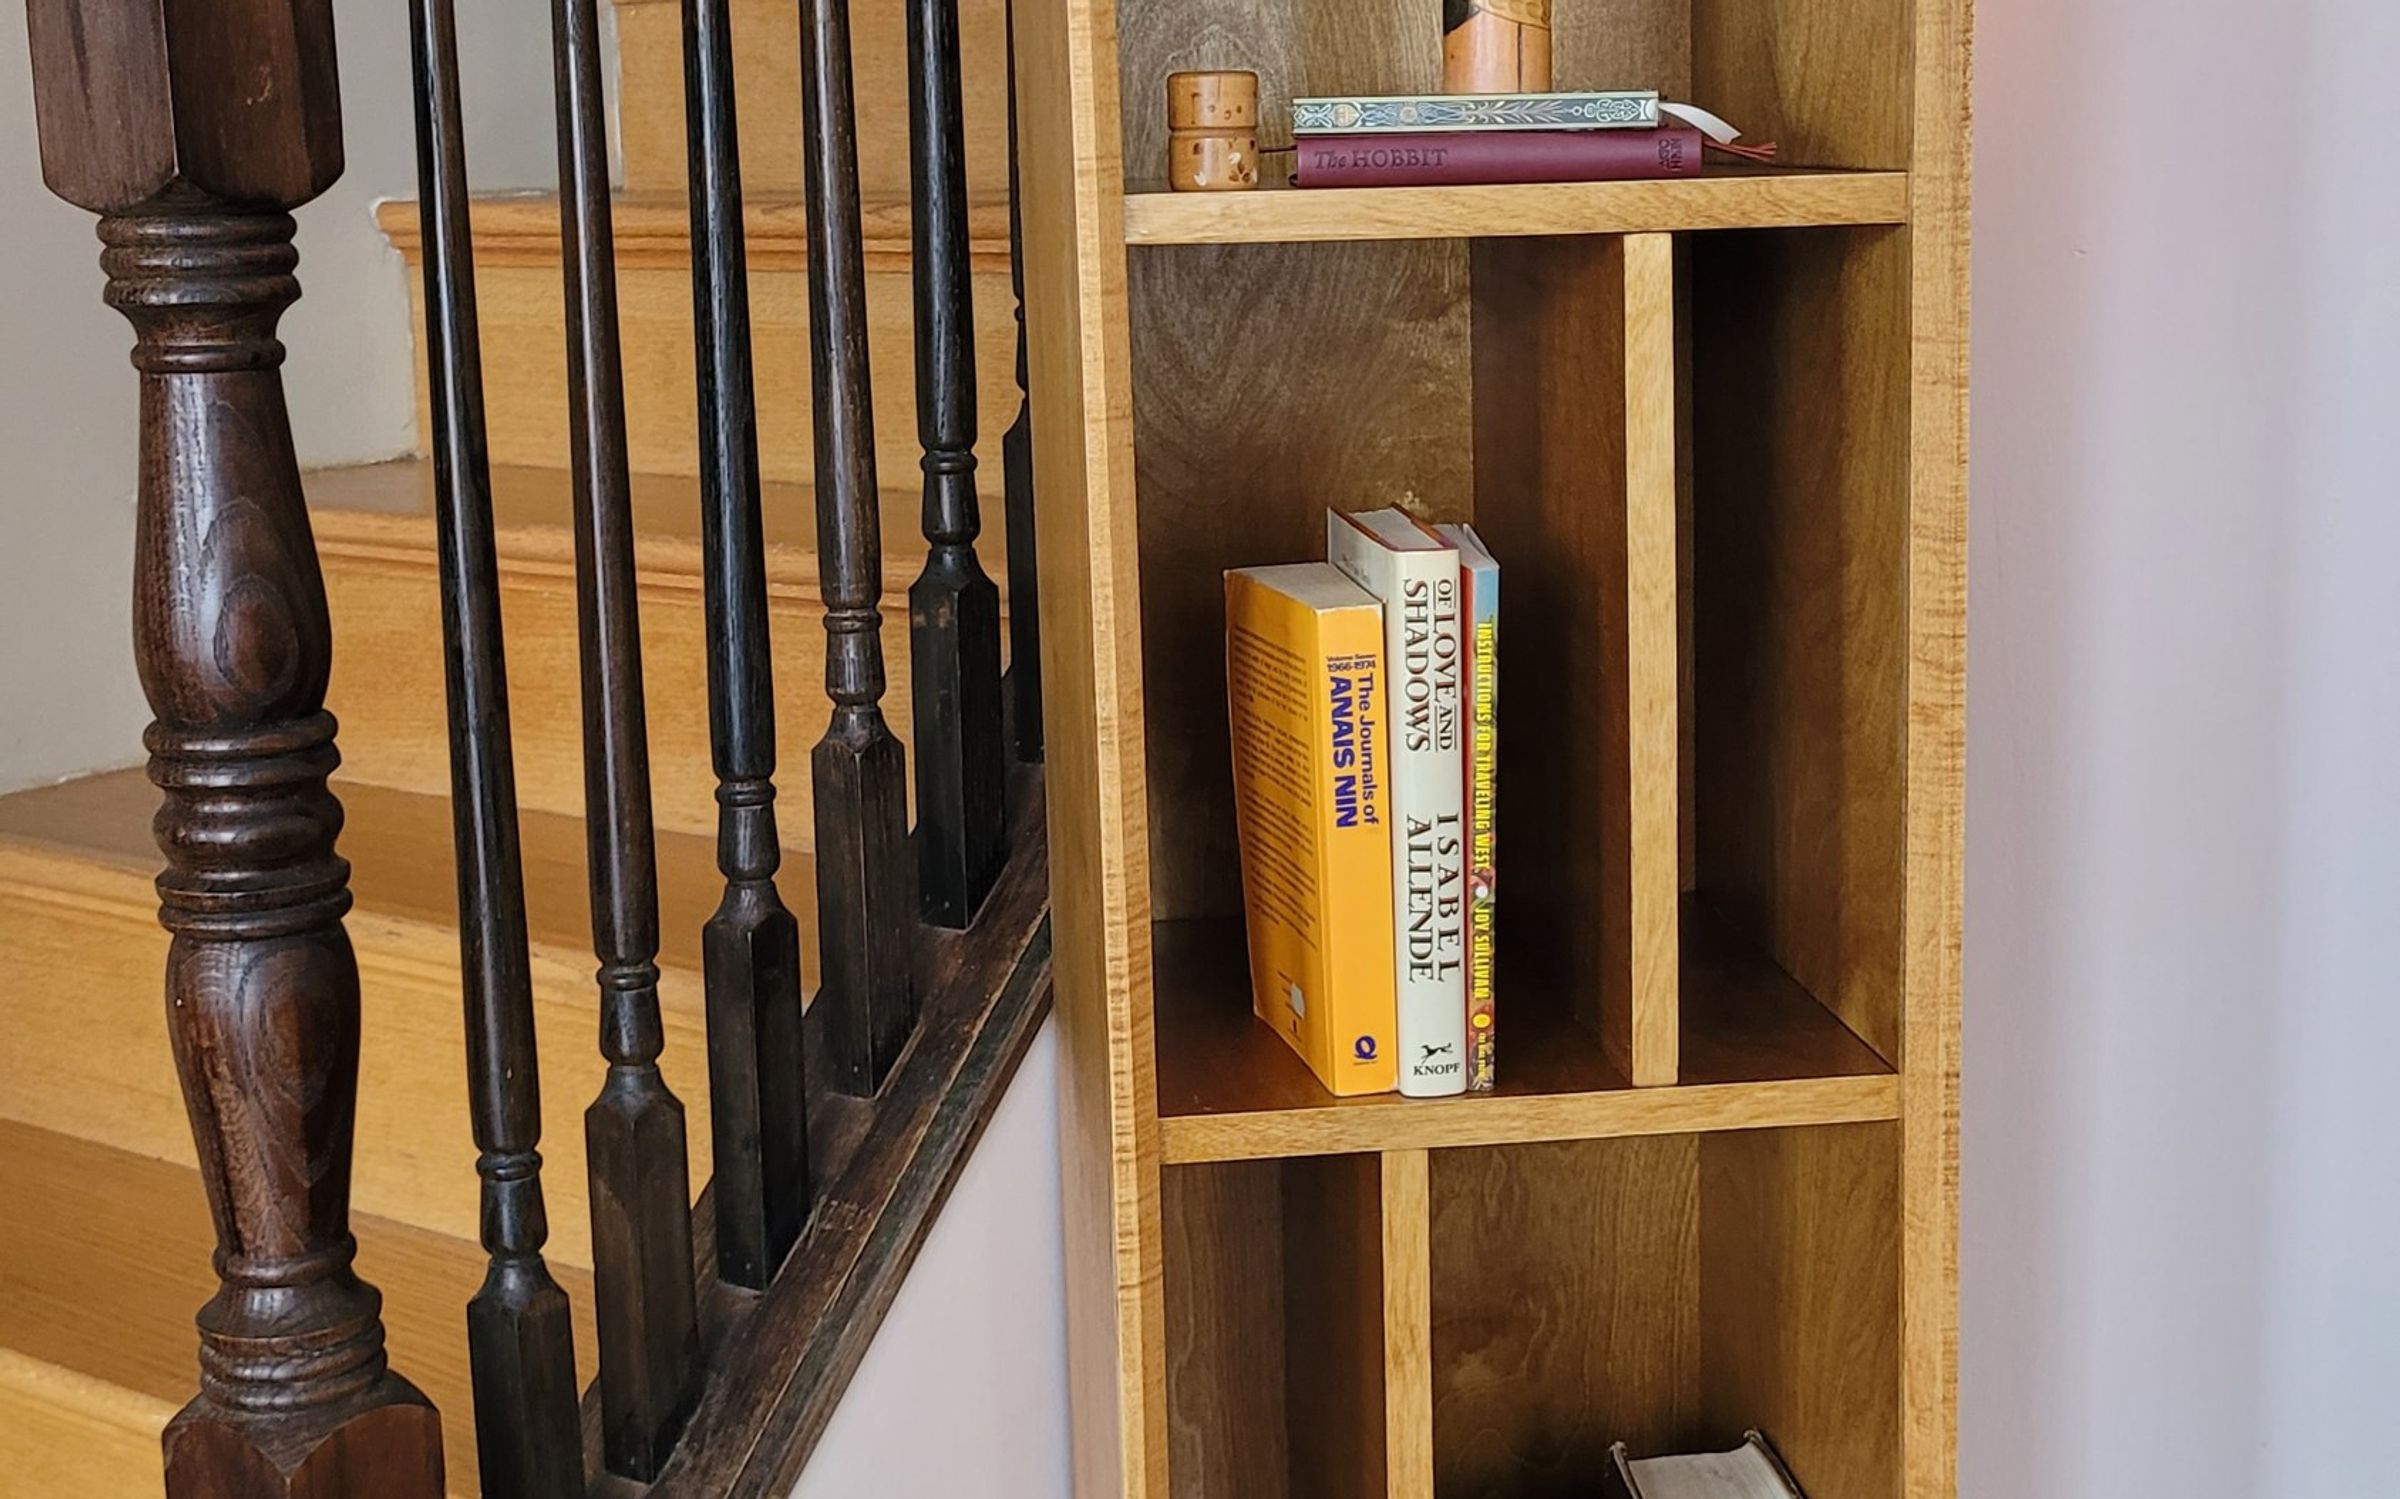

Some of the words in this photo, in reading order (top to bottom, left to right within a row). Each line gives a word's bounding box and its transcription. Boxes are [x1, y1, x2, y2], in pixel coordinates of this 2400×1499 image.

[1314, 151, 1347, 169] The
[1351, 148, 1448, 168] HOBBIT
[1436, 579, 1454, 608] OF
[1403, 579, 1431, 752] SHADOWS
[1433, 613, 1457, 703] LOVE
[1476, 622, 1493, 722] INSTRUCTIONS
[1358, 672, 1374, 712] The
[1329, 676, 1355, 769] ANAIS
[1437, 704, 1454, 750] AND
[1476, 725, 1491, 751] FOR
[1359, 714, 1378, 801] Journals
[1334, 774, 1359, 828] NIN
[1363, 804, 1380, 824] of
[1475, 755, 1491, 830] TRAVELING
[1475, 833, 1491, 869] WEST
[1406, 813, 1434, 983] ALLENDE
[1436, 813, 1460, 984] ISABEL
[1475, 907, 1490, 931] JOY
[1474, 935, 1490, 999] SULLIVAN
[1413, 1062, 1461, 1076] KNOPF
